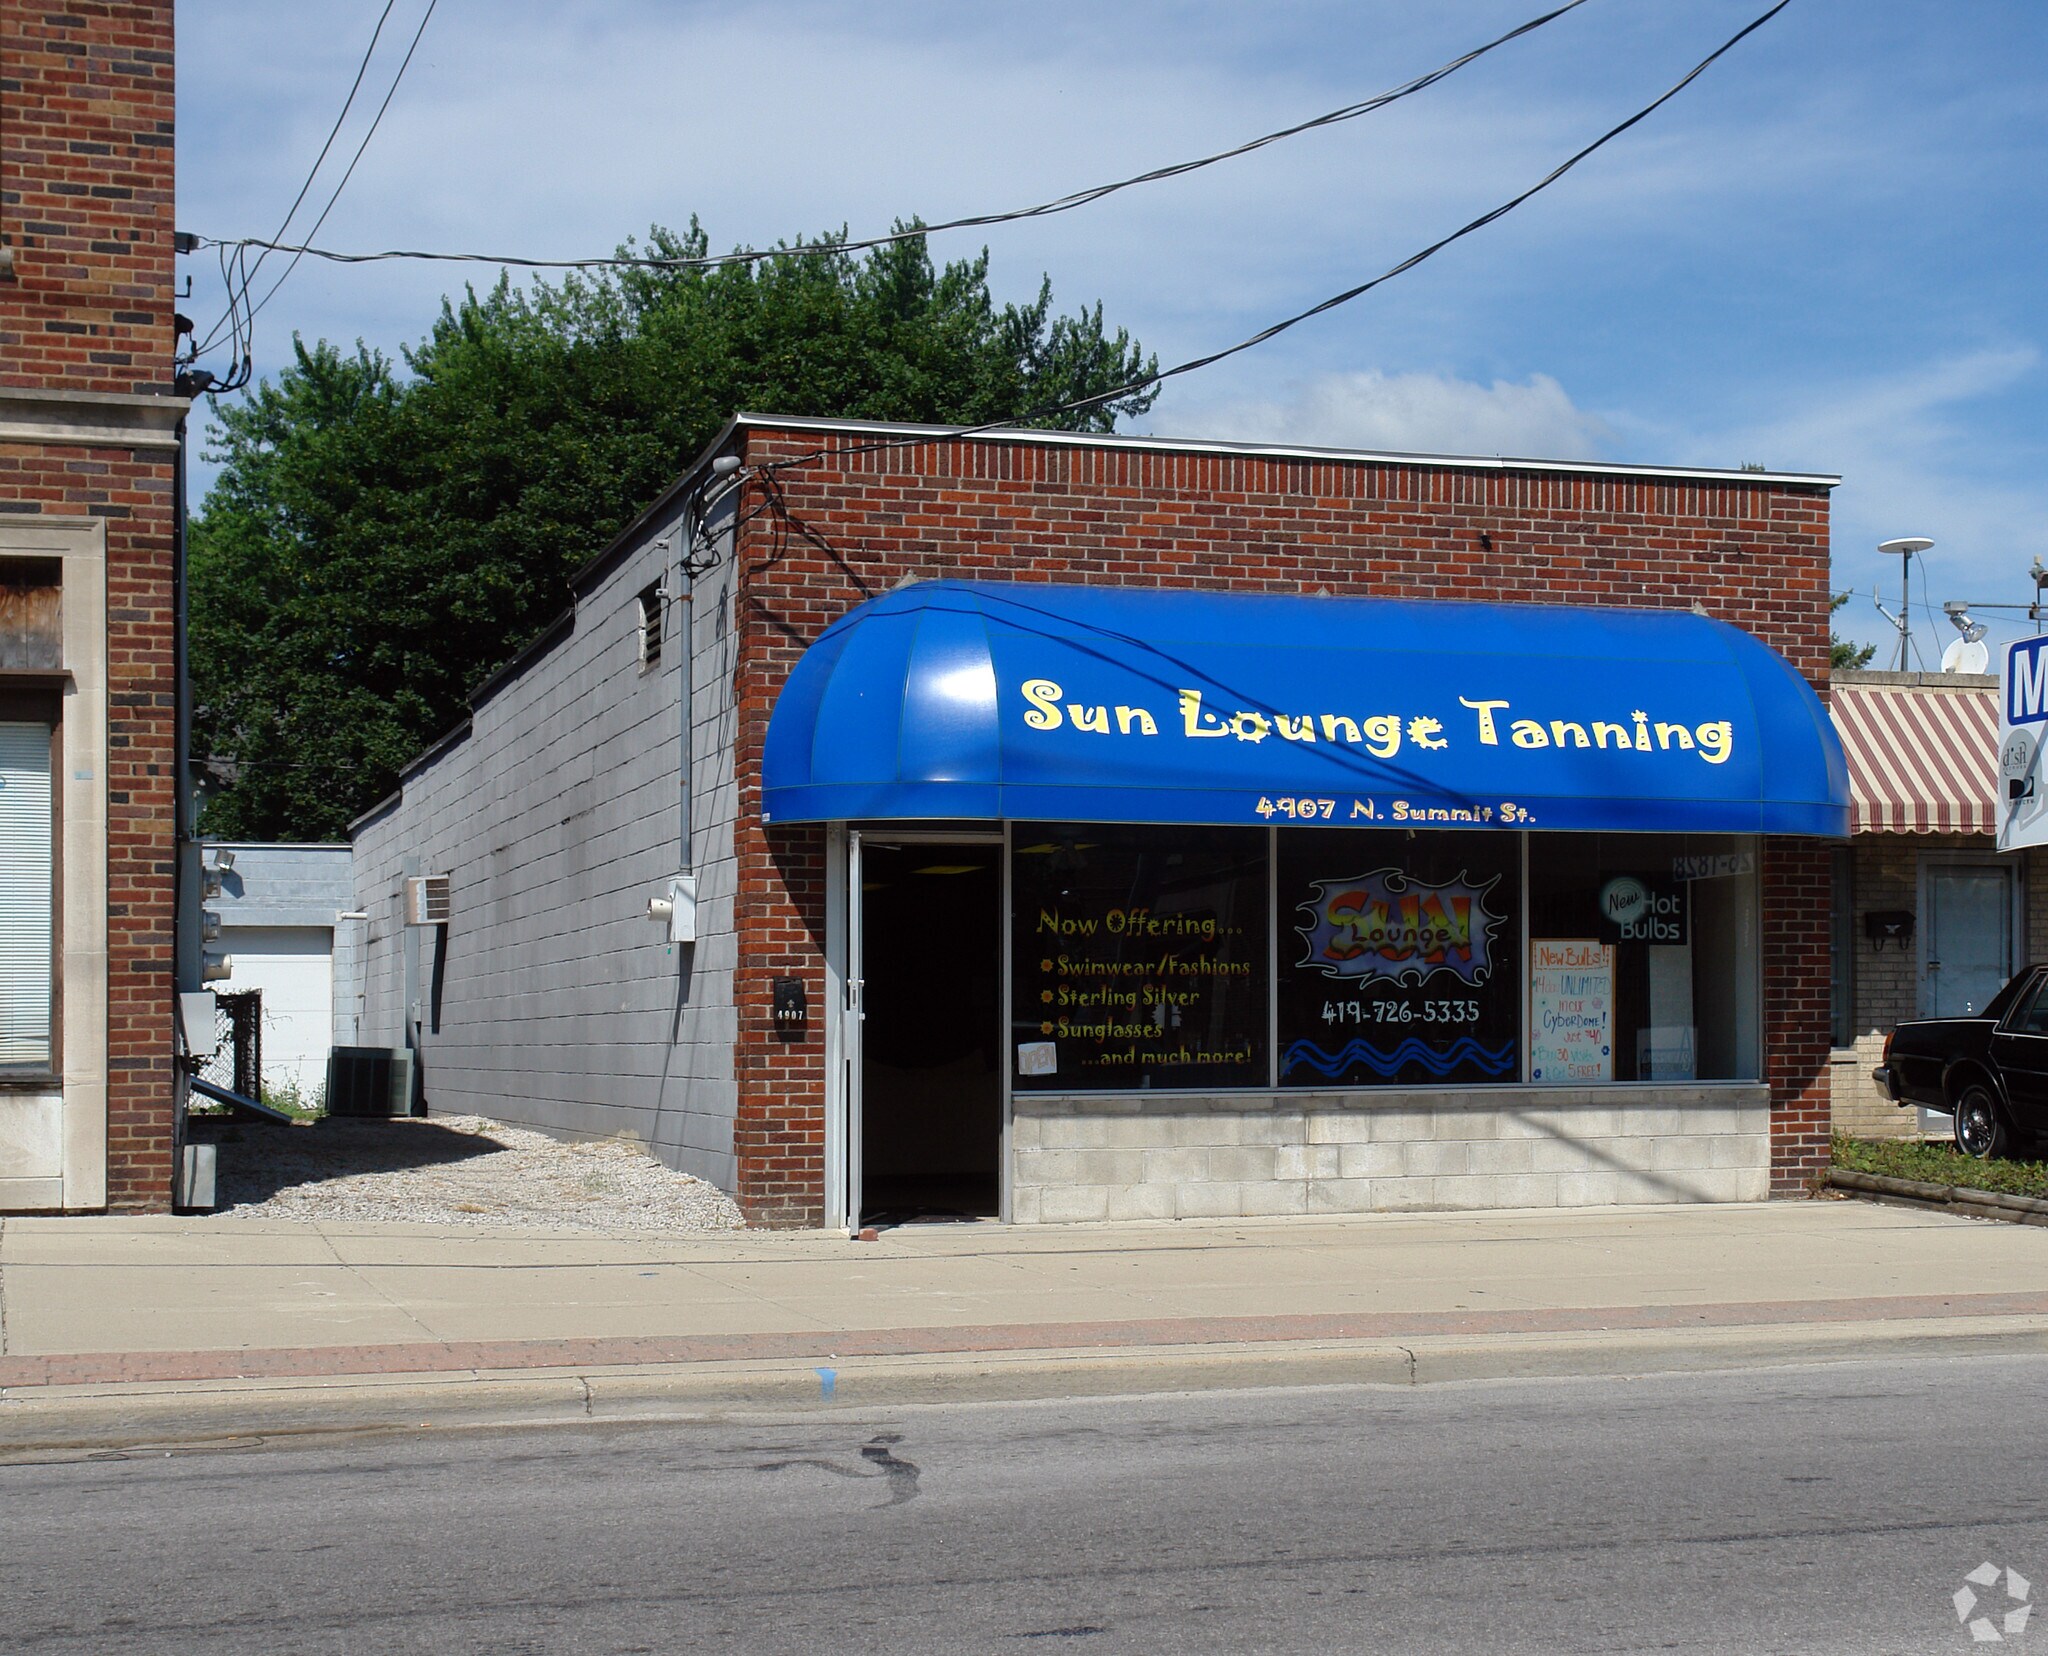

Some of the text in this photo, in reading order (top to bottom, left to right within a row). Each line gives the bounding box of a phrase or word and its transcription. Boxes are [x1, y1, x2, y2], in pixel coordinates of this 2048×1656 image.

[1020, 678, 1733, 764] Sun Lounge Tanning
[1255, 797, 1537, 823] 4907 N. Summit St.
[1609, 892, 1641, 915] New
[1642, 891, 1680, 914] Hot
[1036, 905, 1099, 937] Now
[1322, 890, 1472, 964] SUN
[1620, 917, 1680, 940] Bulbs
[1351, 923, 1453, 947] Lounge
[1057, 953, 1251, 977] Swimwear/Fashions
[1540, 946, 1564, 966] New
[1560, 974, 1612, 996] UNLIMITED
[1057, 984, 1200, 1012] Sterling Silver
[778, 1010, 803, 1020] 4907
[1321, 1000, 1480, 1025] 419-726-5335
[1057, 1015, 1163, 1044] Sunglasses
[1141, 1044, 1191, 1065] much
[1196, 1044, 1251, 1065] more!
